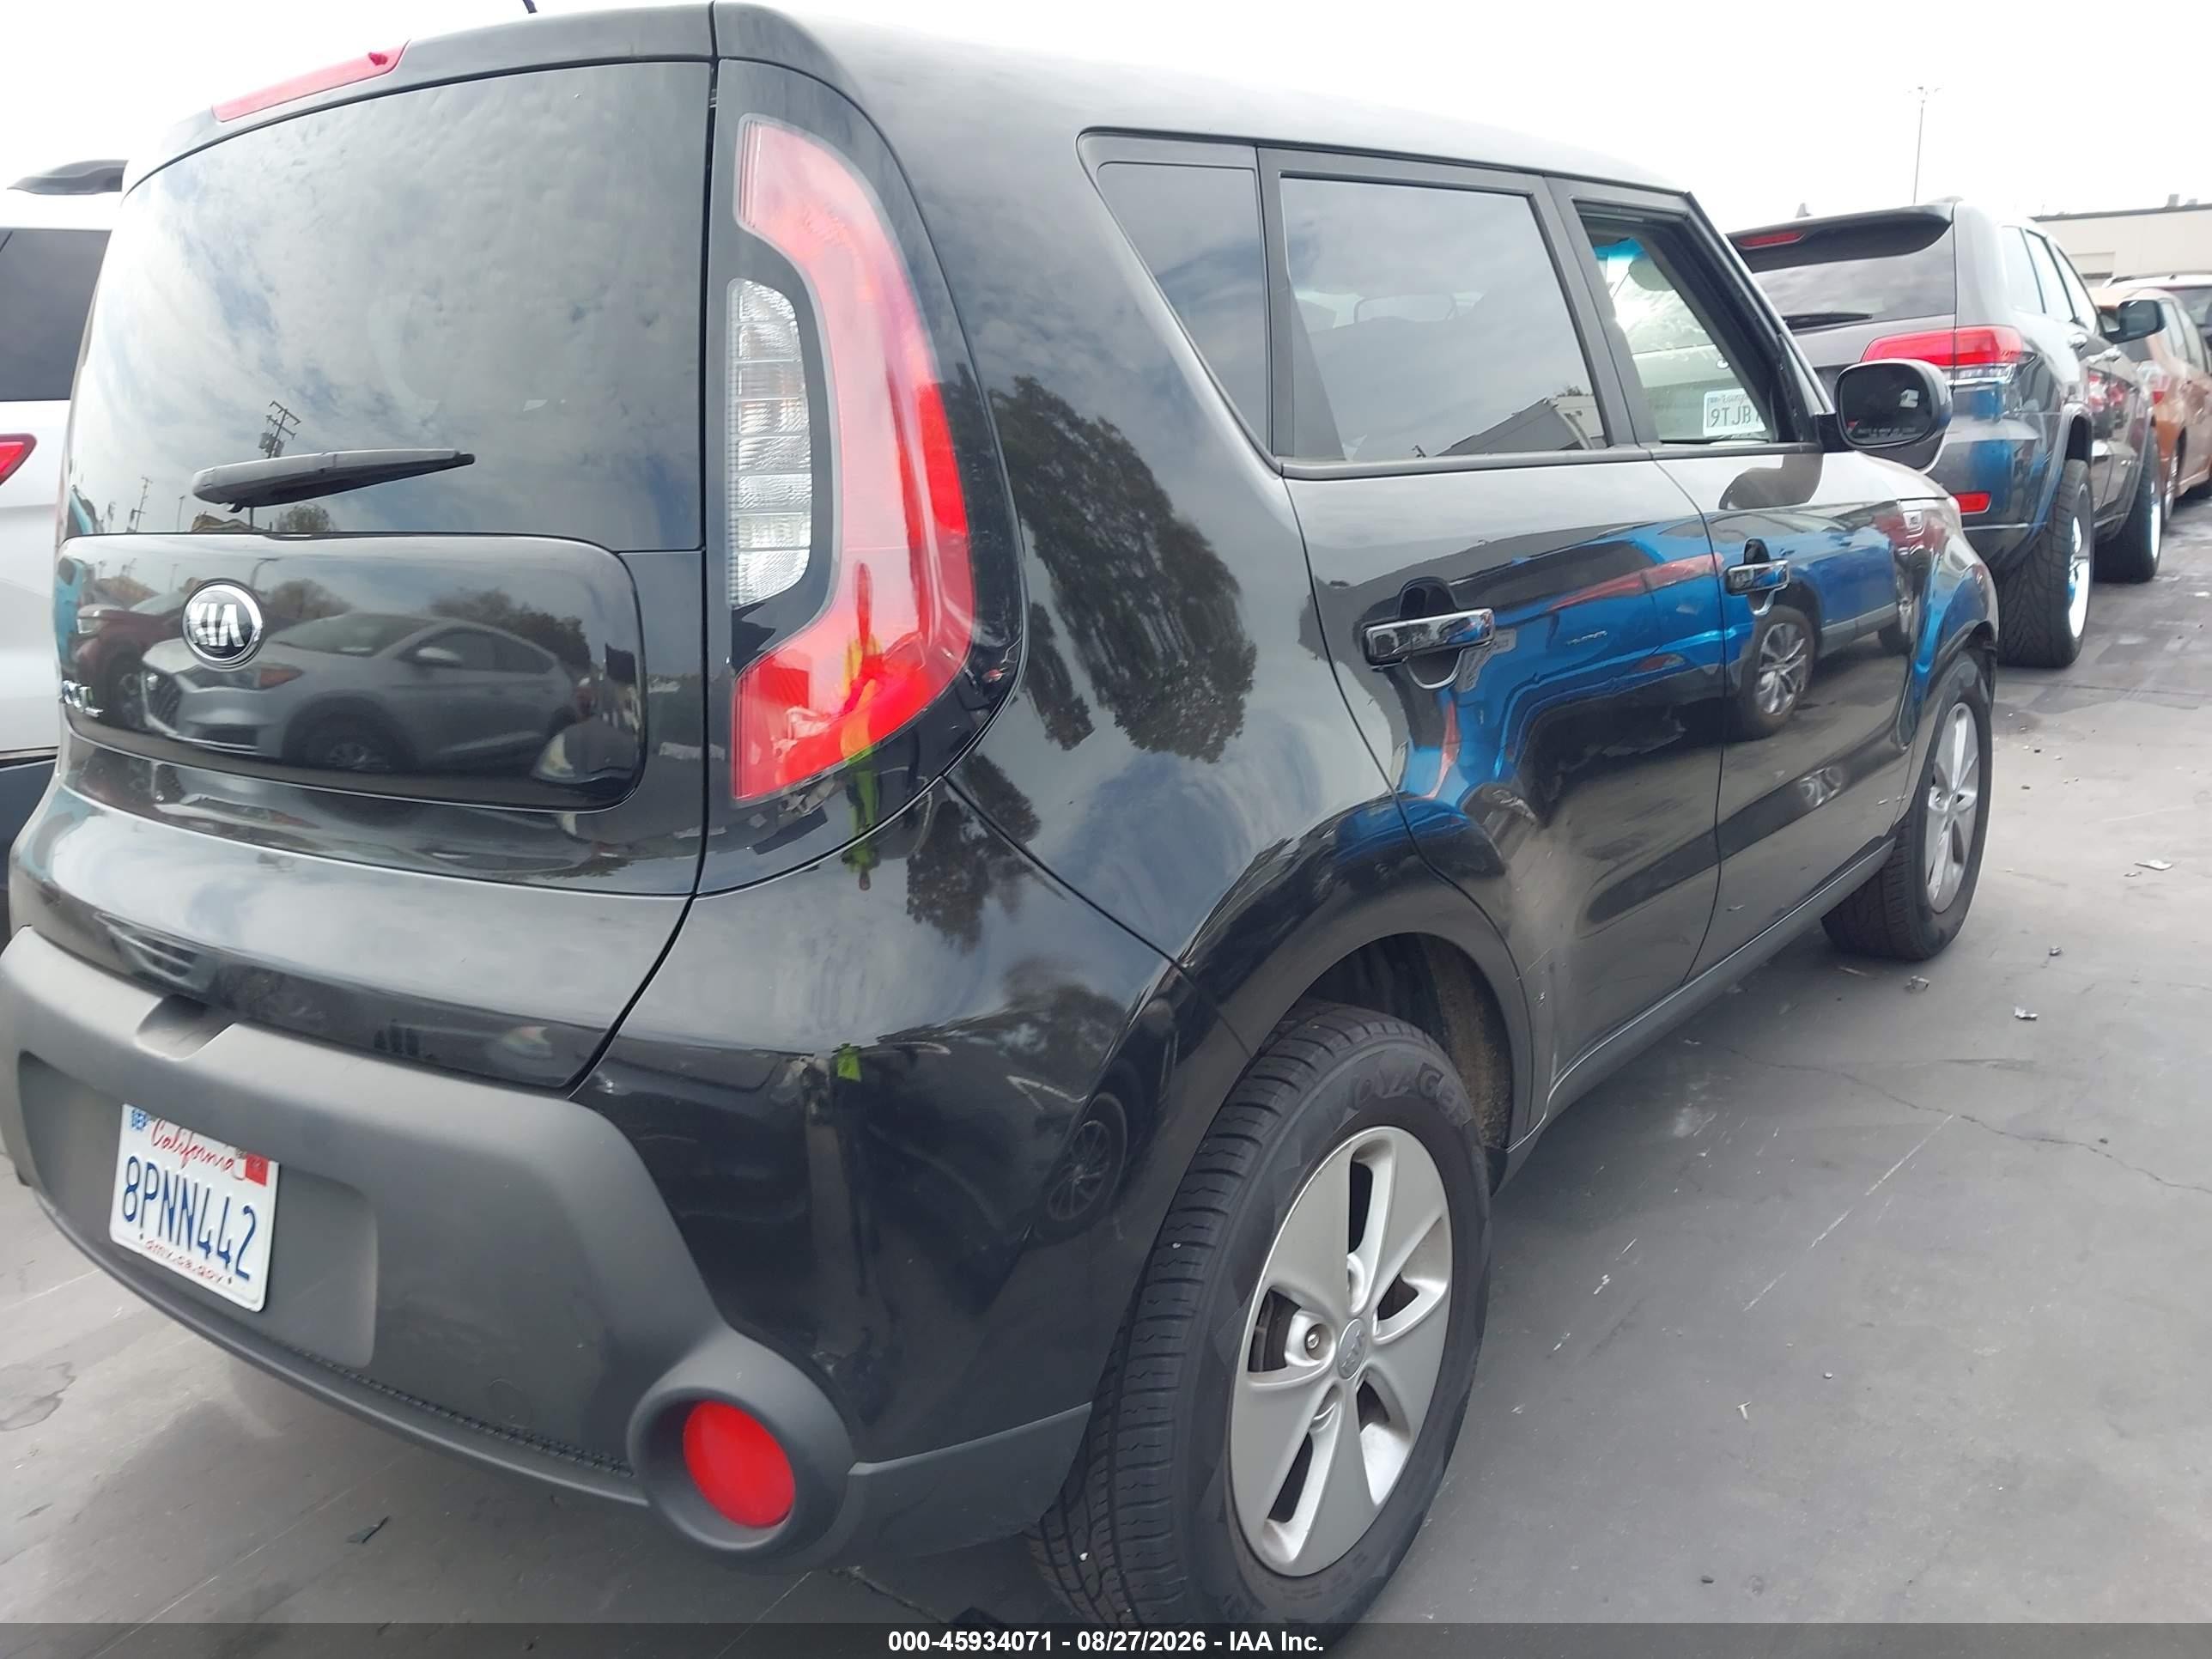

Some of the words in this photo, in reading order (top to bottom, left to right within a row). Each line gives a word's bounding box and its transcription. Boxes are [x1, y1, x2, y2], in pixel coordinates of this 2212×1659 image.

[188, 602, 246, 647] KIA
[150, 1118, 234, 1170] California
[122, 1155, 257, 1282] 8PNN442
